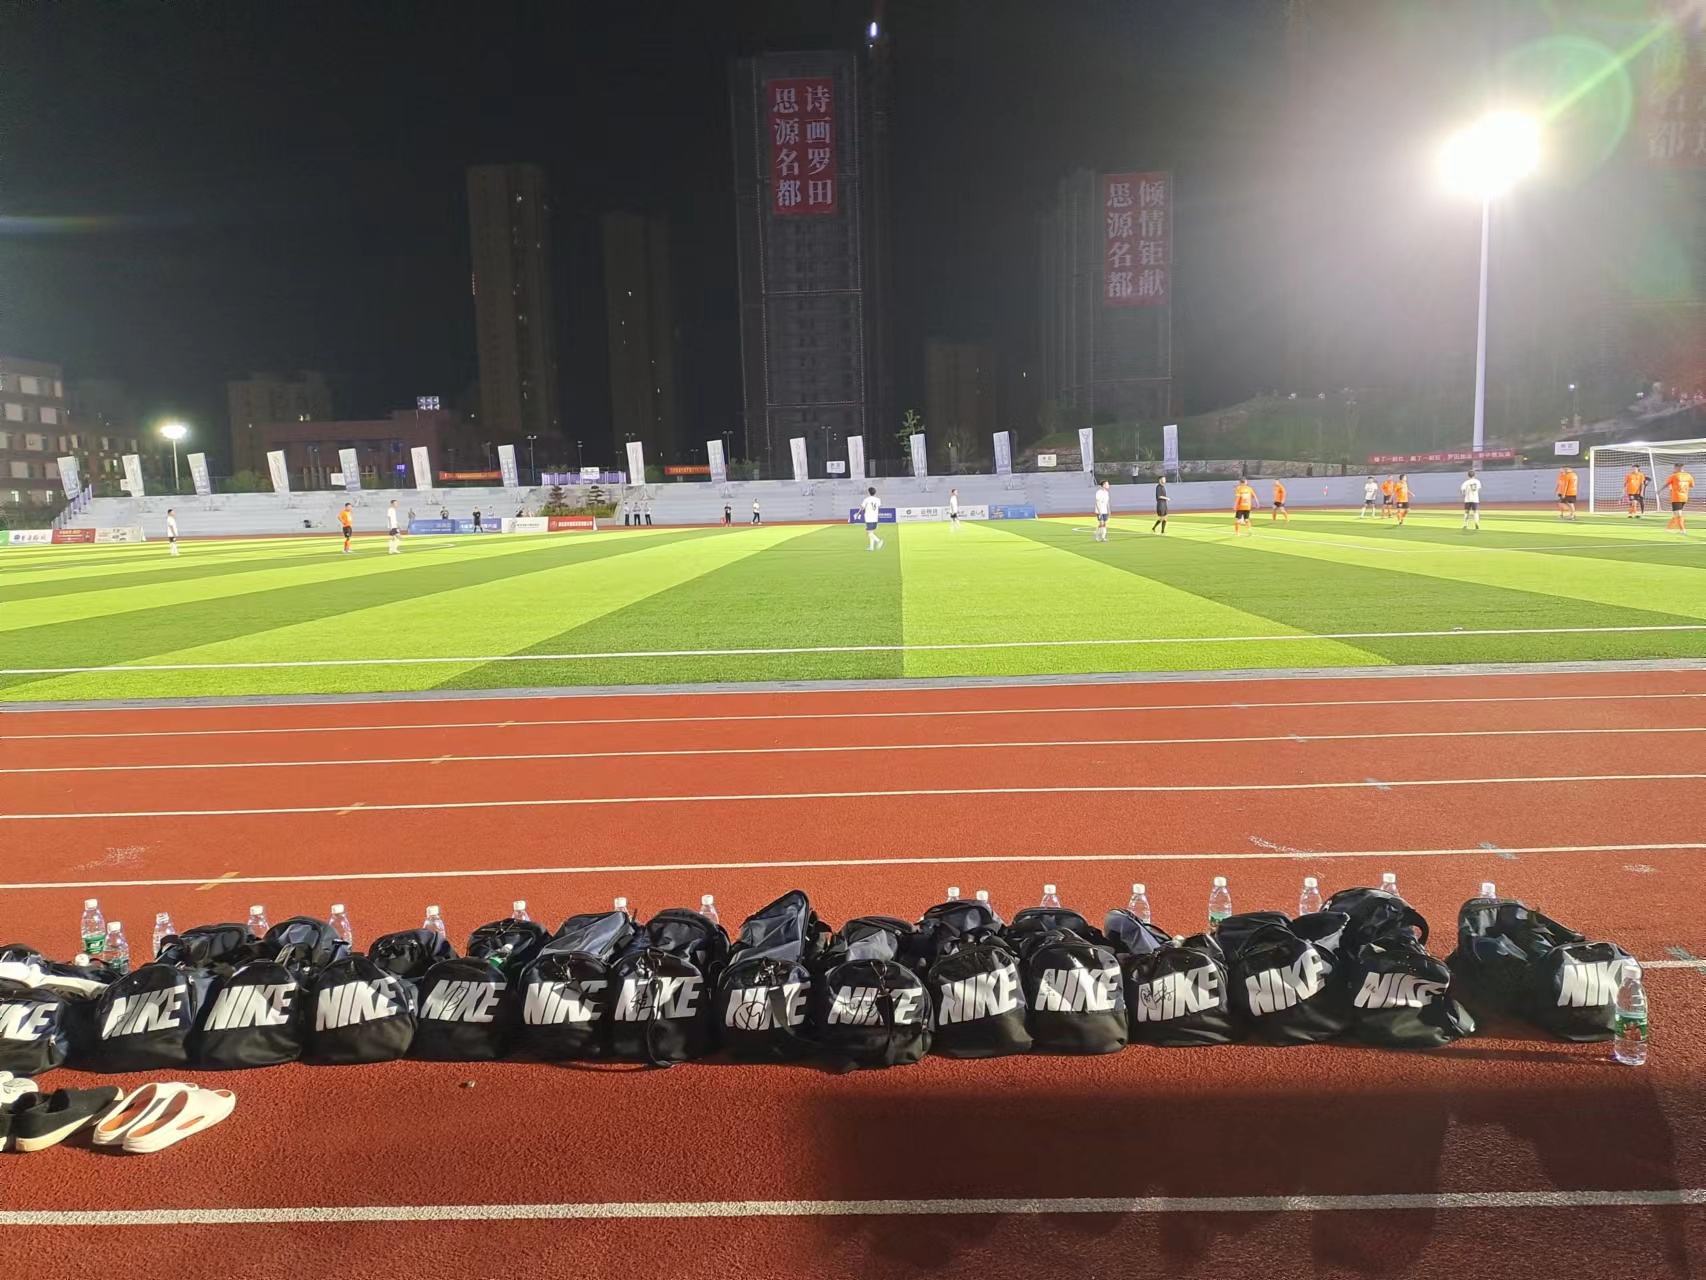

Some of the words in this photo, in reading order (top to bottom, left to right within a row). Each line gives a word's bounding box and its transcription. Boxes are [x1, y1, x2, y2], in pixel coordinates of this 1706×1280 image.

[773, 87, 801, 207] 思源名都
[804, 85, 832, 205] 诗画罗田
[1107, 183, 1133, 297] 思源名都
[203, 982, 296, 1031] NIKE
[316, 976, 397, 1031] NIKE
[420, 979, 507, 1022] NIKE
[524, 980, 607, 1025] NIKE
[939, 963, 1017, 1026] NIKE
[1035, 966, 1120, 1011] NIKE
[1137, 963, 1219, 1022] NIKE
[1246, 949, 1325, 1016] NIKE
[1354, 971, 1447, 1009] NIKE
[1557, 959, 1640, 1008] NIK
[0, 1002, 58, 1041] KE
[102, 983, 186, 1040] NIKE
